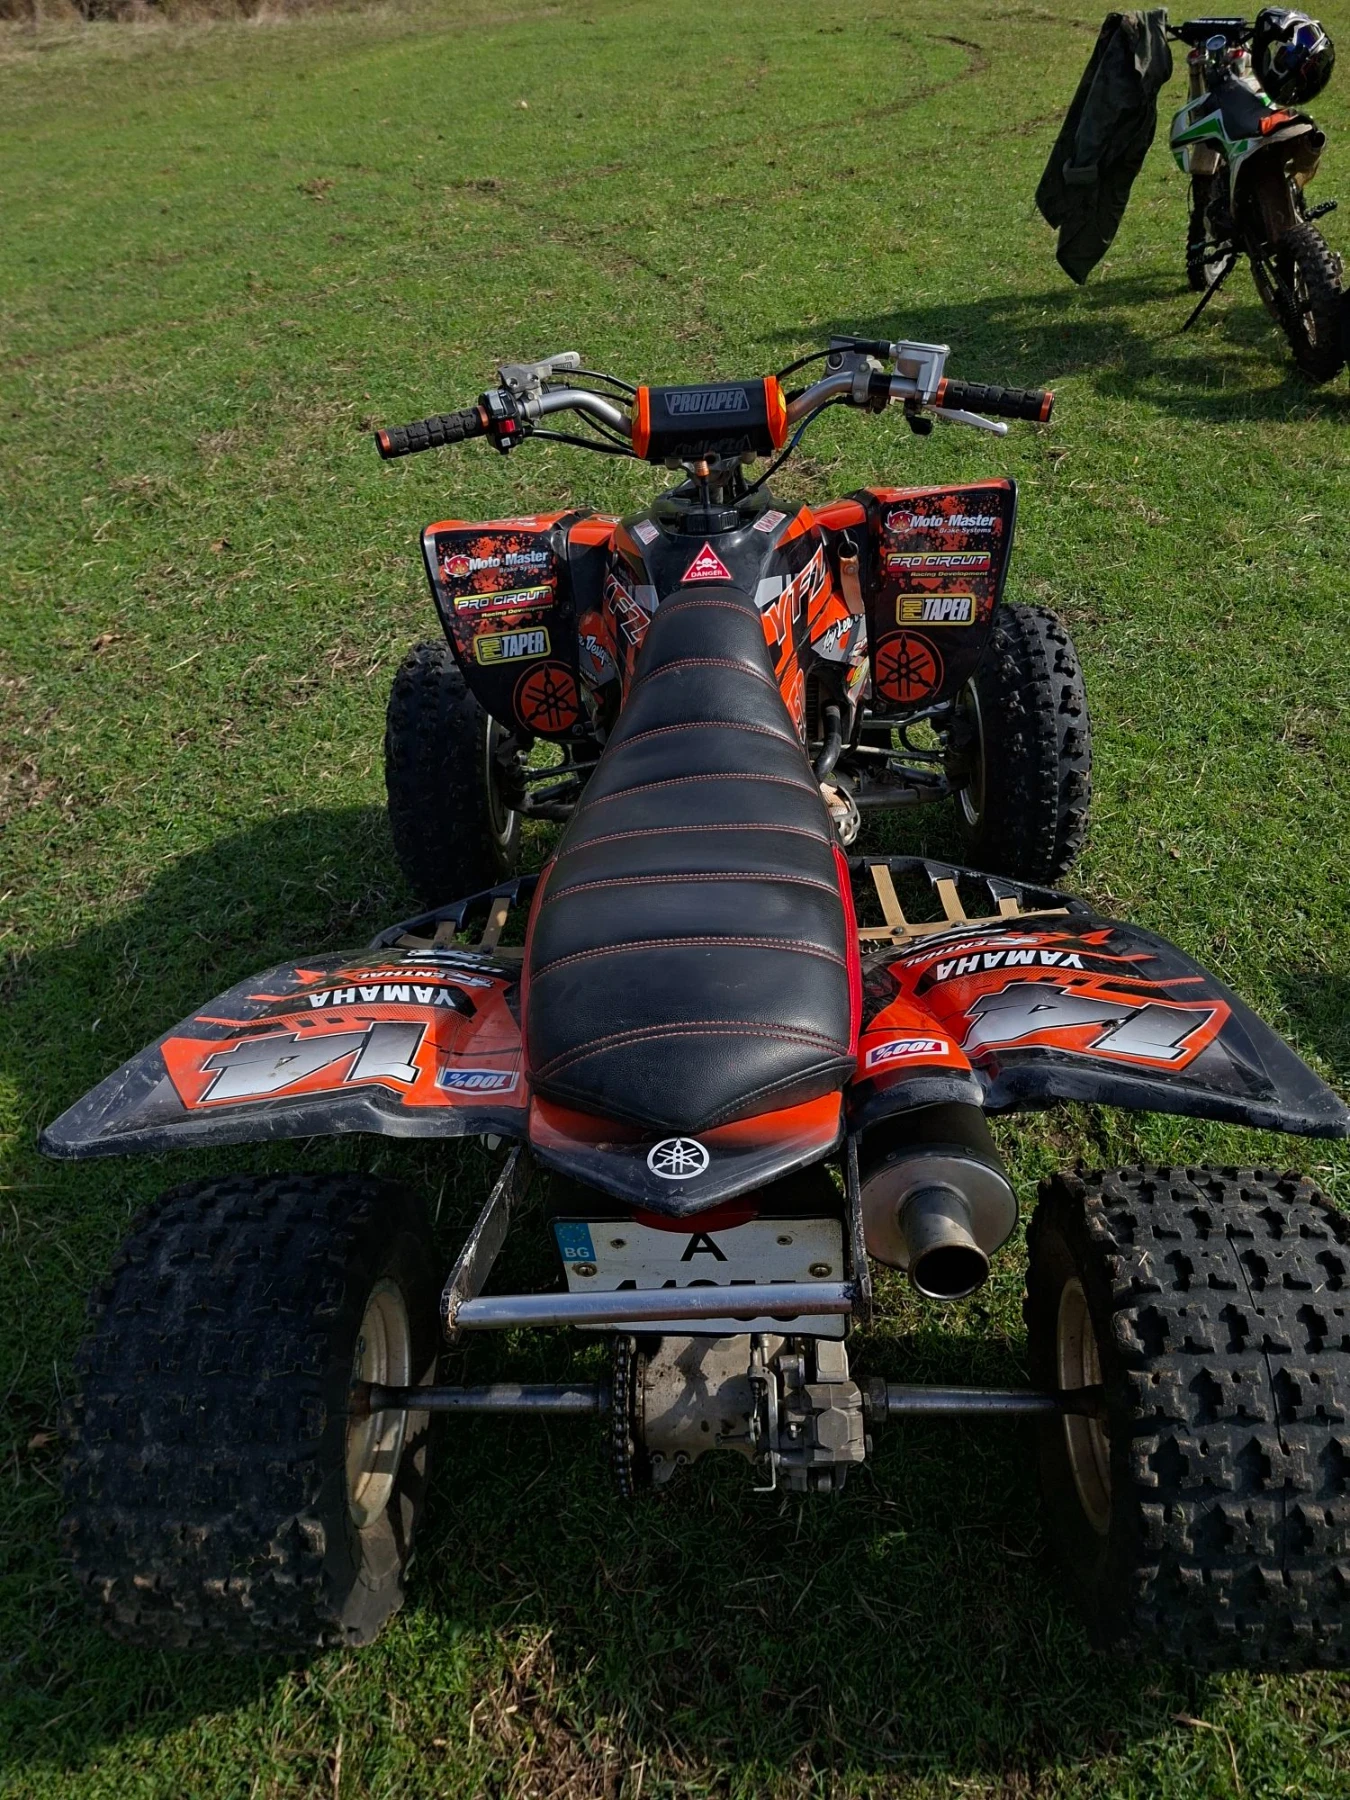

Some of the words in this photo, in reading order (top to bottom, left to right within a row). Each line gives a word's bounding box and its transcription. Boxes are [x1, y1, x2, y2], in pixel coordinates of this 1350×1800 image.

[670, 391, 745, 413] PROTAPER
[520, 562, 546, 572] Systems
[890, 557, 922, 568] PRO
[925, 556, 988, 568] CIRCUIT
[691, 570, 722, 578] DANGER
[458, 598, 490, 610] PRO
[494, 589, 549, 606] CIRCUIT
[764, 543, 826, 646] YFZ
[481, 610, 507, 618] Racing
[923, 598, 971, 621] TAPER
[502, 631, 545, 658] TAPER
[937, 950, 1084, 980] YAMAHA
[308, 985, 456, 1008] YAMAHA
[960, 982, 1217, 1062] 14
[876, 1041, 936, 1060] 100%
[197, 1021, 430, 1104] 14
[450, 1073, 507, 1088] 100%
[564, 1247, 589, 1258] BG
[680, 1232, 728, 1261] A
